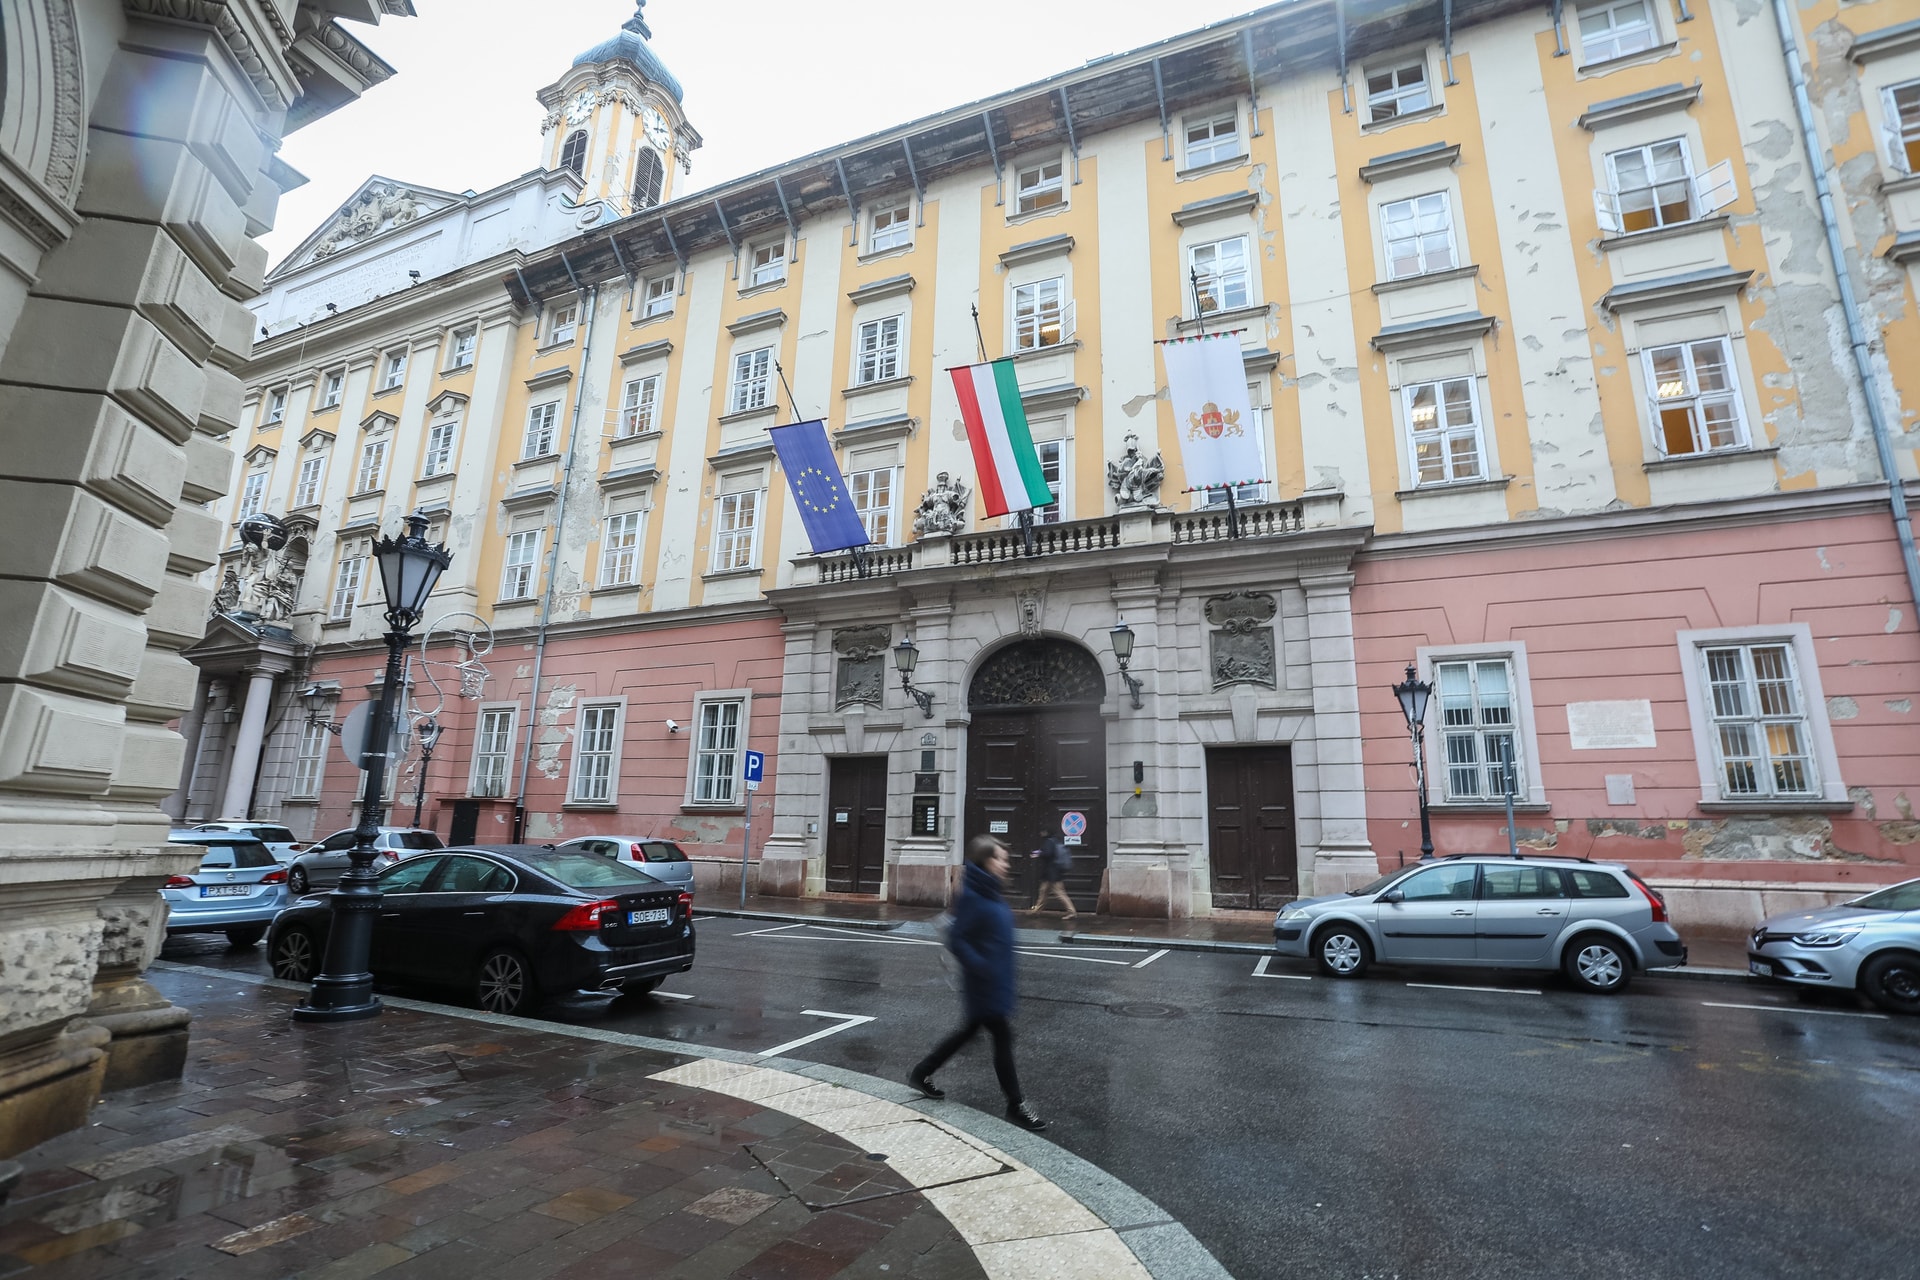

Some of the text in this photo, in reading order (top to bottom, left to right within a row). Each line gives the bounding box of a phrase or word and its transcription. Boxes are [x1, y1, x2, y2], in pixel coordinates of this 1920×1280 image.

[748, 755, 760, 777] P
[208, 886, 249, 896] PXT-640
[629, 896, 673, 904] VOLVO
[633, 909, 666, 923] SOE-735
